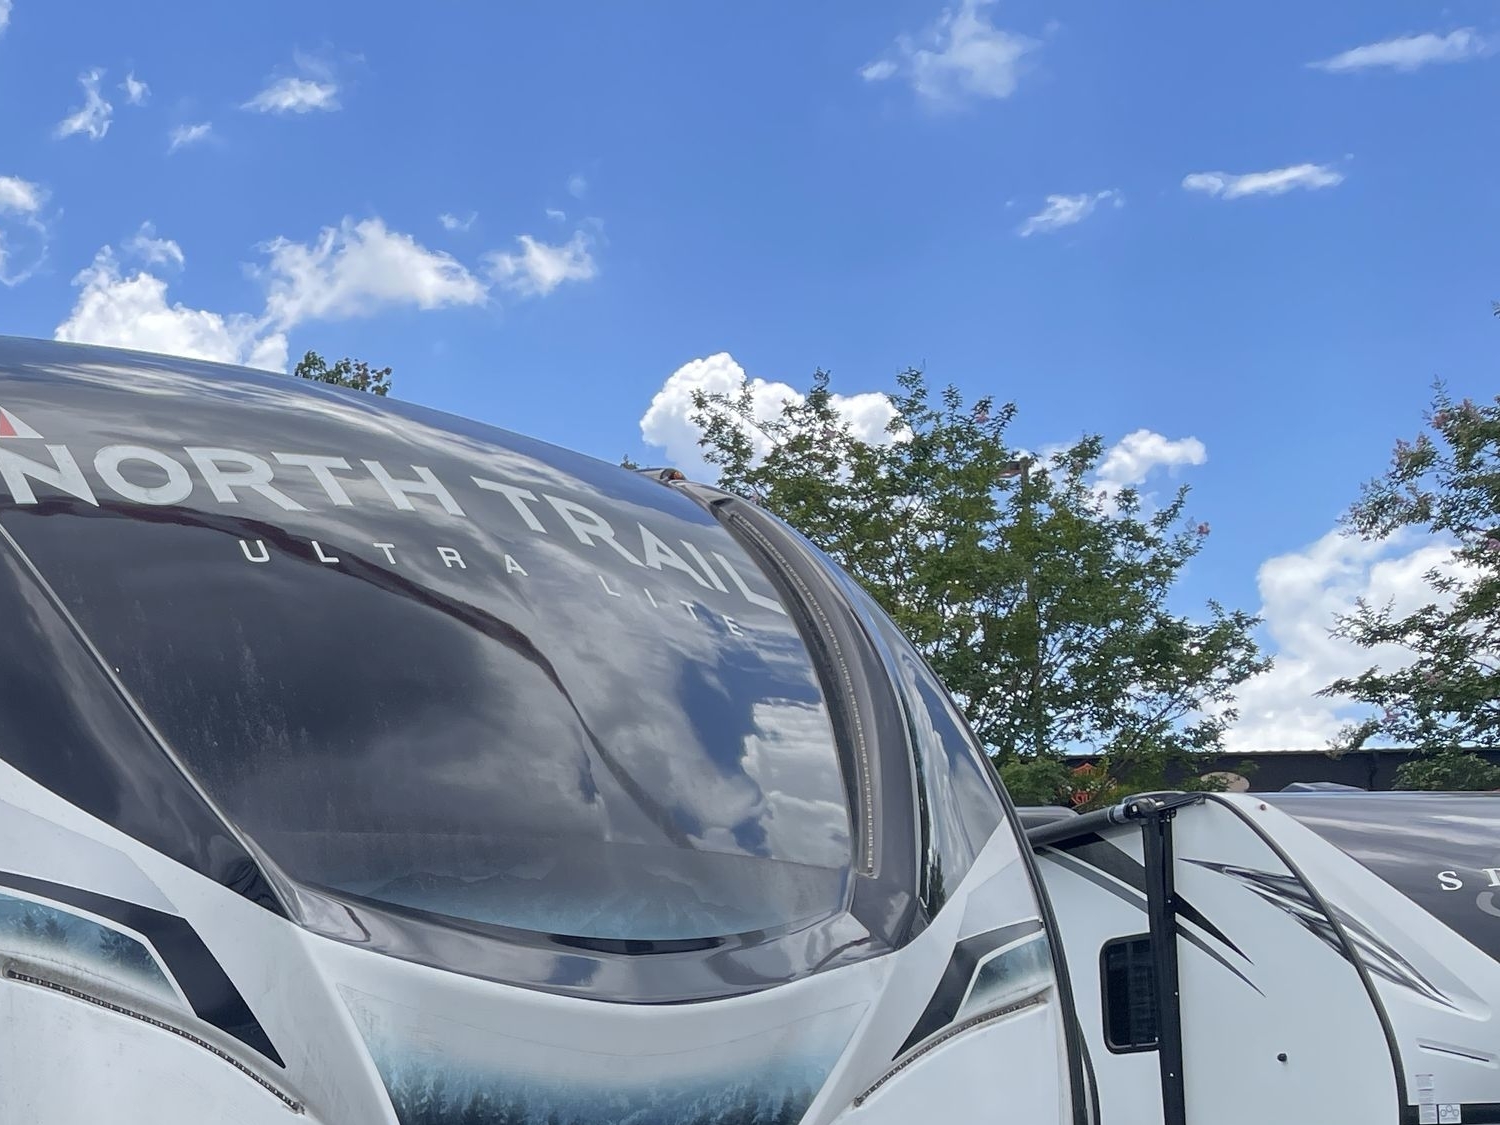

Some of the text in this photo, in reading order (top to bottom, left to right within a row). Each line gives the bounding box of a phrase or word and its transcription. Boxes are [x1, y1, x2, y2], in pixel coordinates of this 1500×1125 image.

[239, 539, 745, 638] ULTRA LITE
[470, 475, 789, 616] TRAIL
